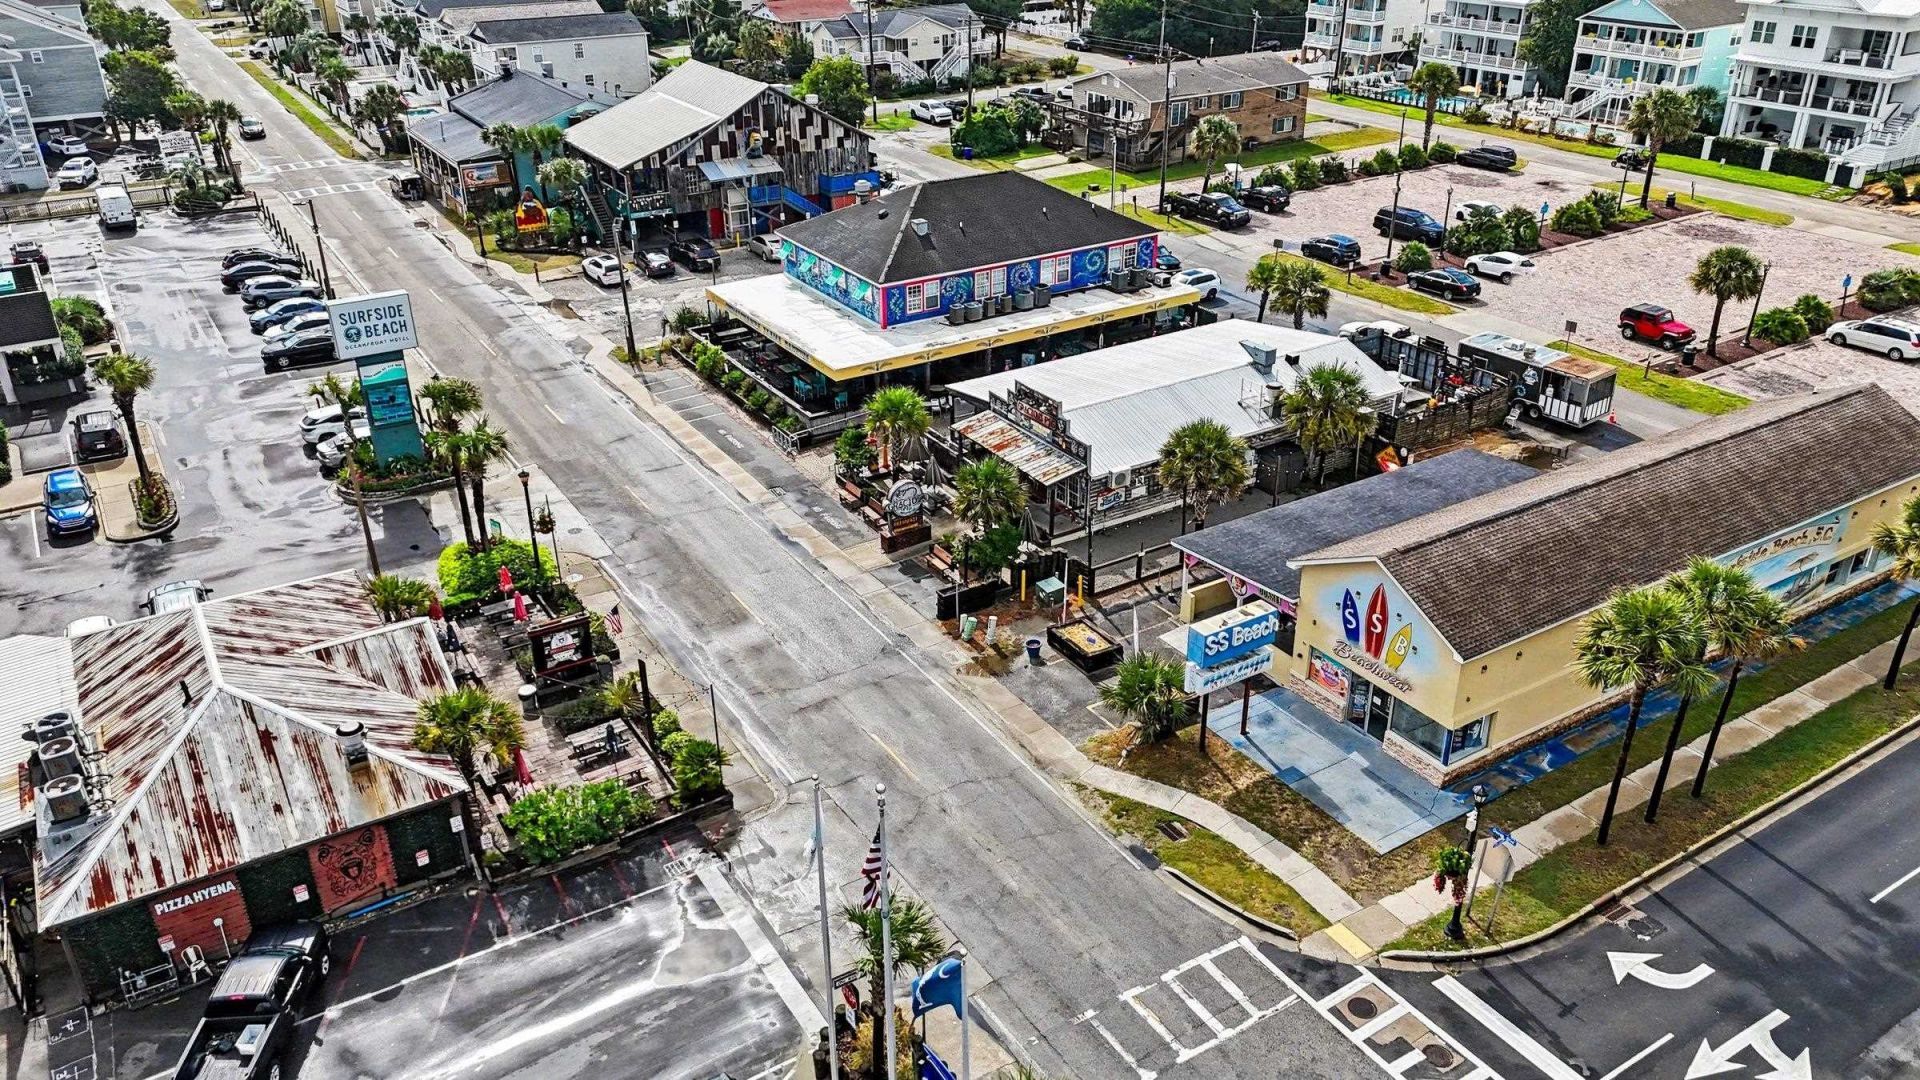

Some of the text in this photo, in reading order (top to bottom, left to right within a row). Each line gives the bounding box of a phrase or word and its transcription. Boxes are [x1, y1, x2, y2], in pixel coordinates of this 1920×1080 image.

[338, 304, 404, 326] SURFSIDE
[364, 319, 408, 338] BEACH
[344, 340, 388, 350] OCEANFRONT
[1205, 614, 1280, 656] SS Beach
[1344, 608, 1408, 656] S S B
[1332, 639, 1413, 693] Beachwear
[154, 880, 236, 915] PIZZA HYENA
